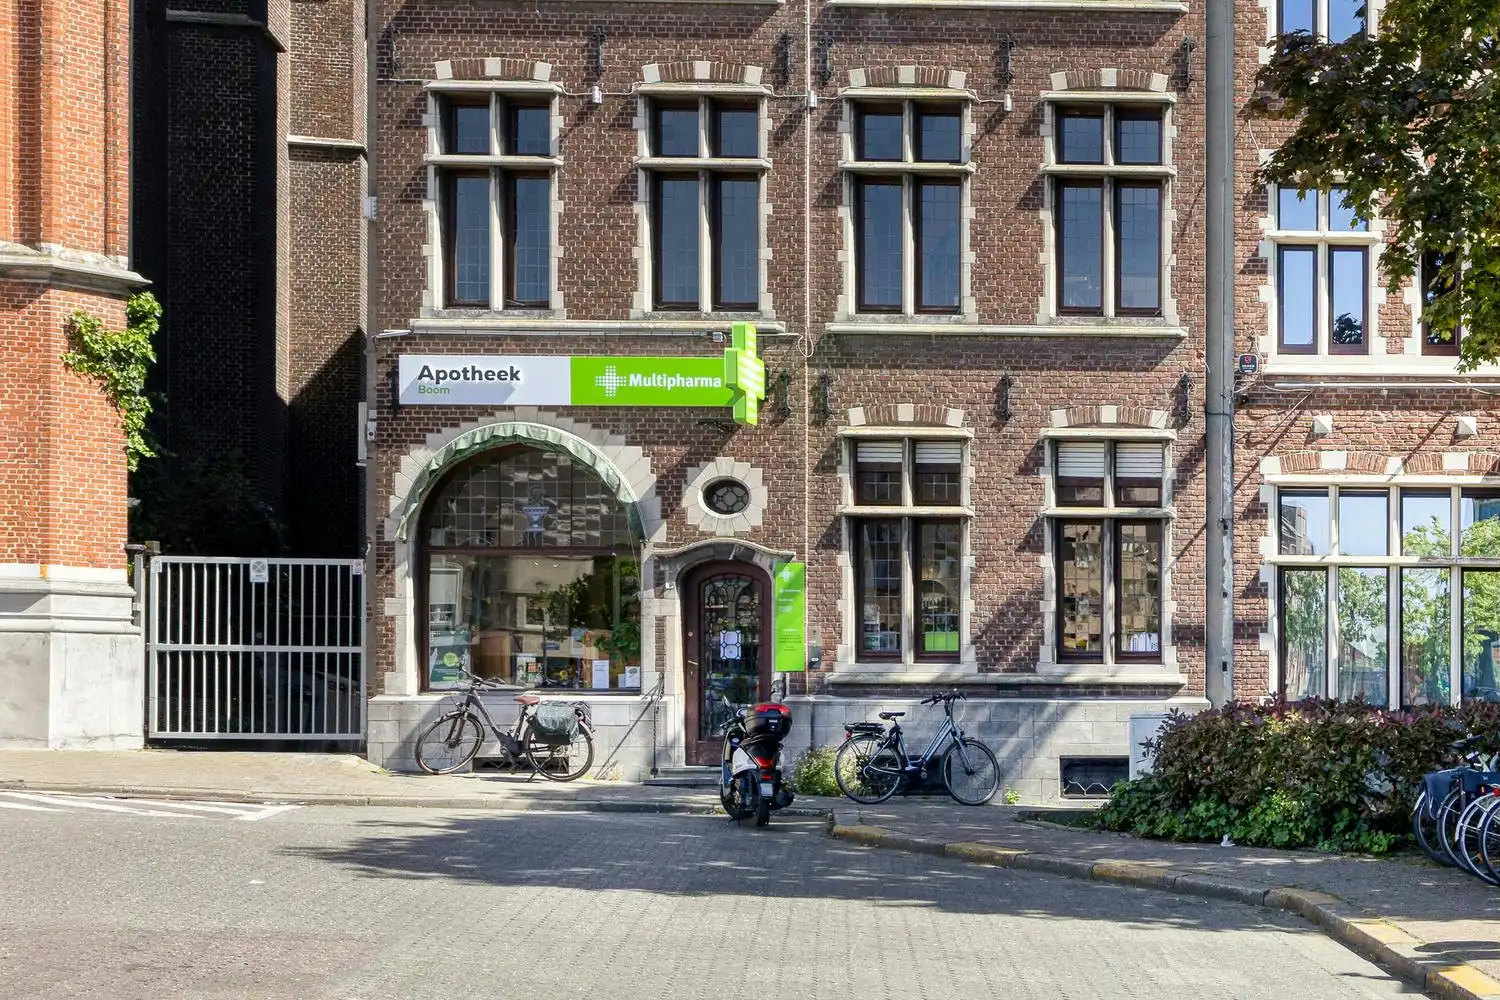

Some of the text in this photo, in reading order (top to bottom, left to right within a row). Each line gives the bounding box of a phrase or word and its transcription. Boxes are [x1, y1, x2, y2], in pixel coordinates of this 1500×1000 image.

[417, 364, 521, 386] Apotheek
[629, 371, 722, 390] Multipharma
[418, 385, 450, 396] Boom
